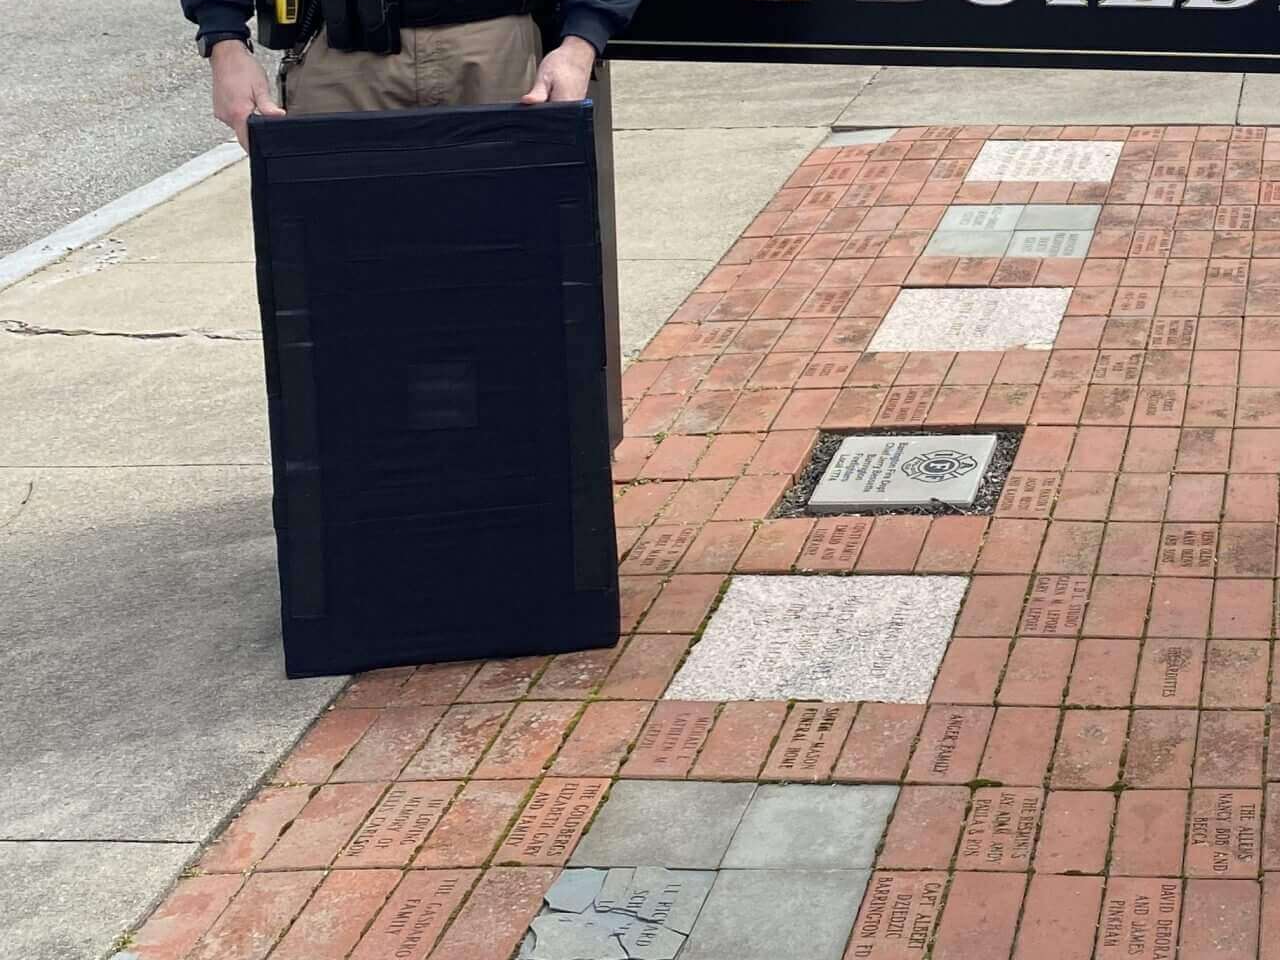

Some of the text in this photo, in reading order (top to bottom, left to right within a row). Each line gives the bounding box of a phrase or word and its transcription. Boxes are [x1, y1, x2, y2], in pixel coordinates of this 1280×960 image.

[1063, 604, 1083, 628] STUDIO
[780, 747, 802, 769] HOME
[932, 744, 956, 775] FAMILY
[375, 796, 424, 849] MEMORY OF
[400, 799, 445, 846] IN LOVING
[505, 791, 551, 846] AND FAMILY
[523, 782, 580, 856] ELIZABETH GARY
[547, 783, 602, 857] THE GOLDBERGS
[969, 799, 993, 827] PAULA
[1021, 797, 1039, 814] THE
[345, 816, 387, 857] CARLSON
[963, 838, 983, 858] RON
[1191, 816, 1209, 846] BECCA
[1212, 792, 1234, 873] NANCY BOB AND
[1237, 803, 1257, 861] THE ALLENS
[434, 878, 459, 896] THE
[1160, 884, 1178, 914] DAVID
[384, 898, 422, 936] FAMILY
[855, 876, 894, 958] BARRINGTON FD
[907, 882, 942, 950] CAPT ALBERT
[1104, 899, 1127, 948] PINKHAM
[1127, 895, 1151, 955] AND JAMES
